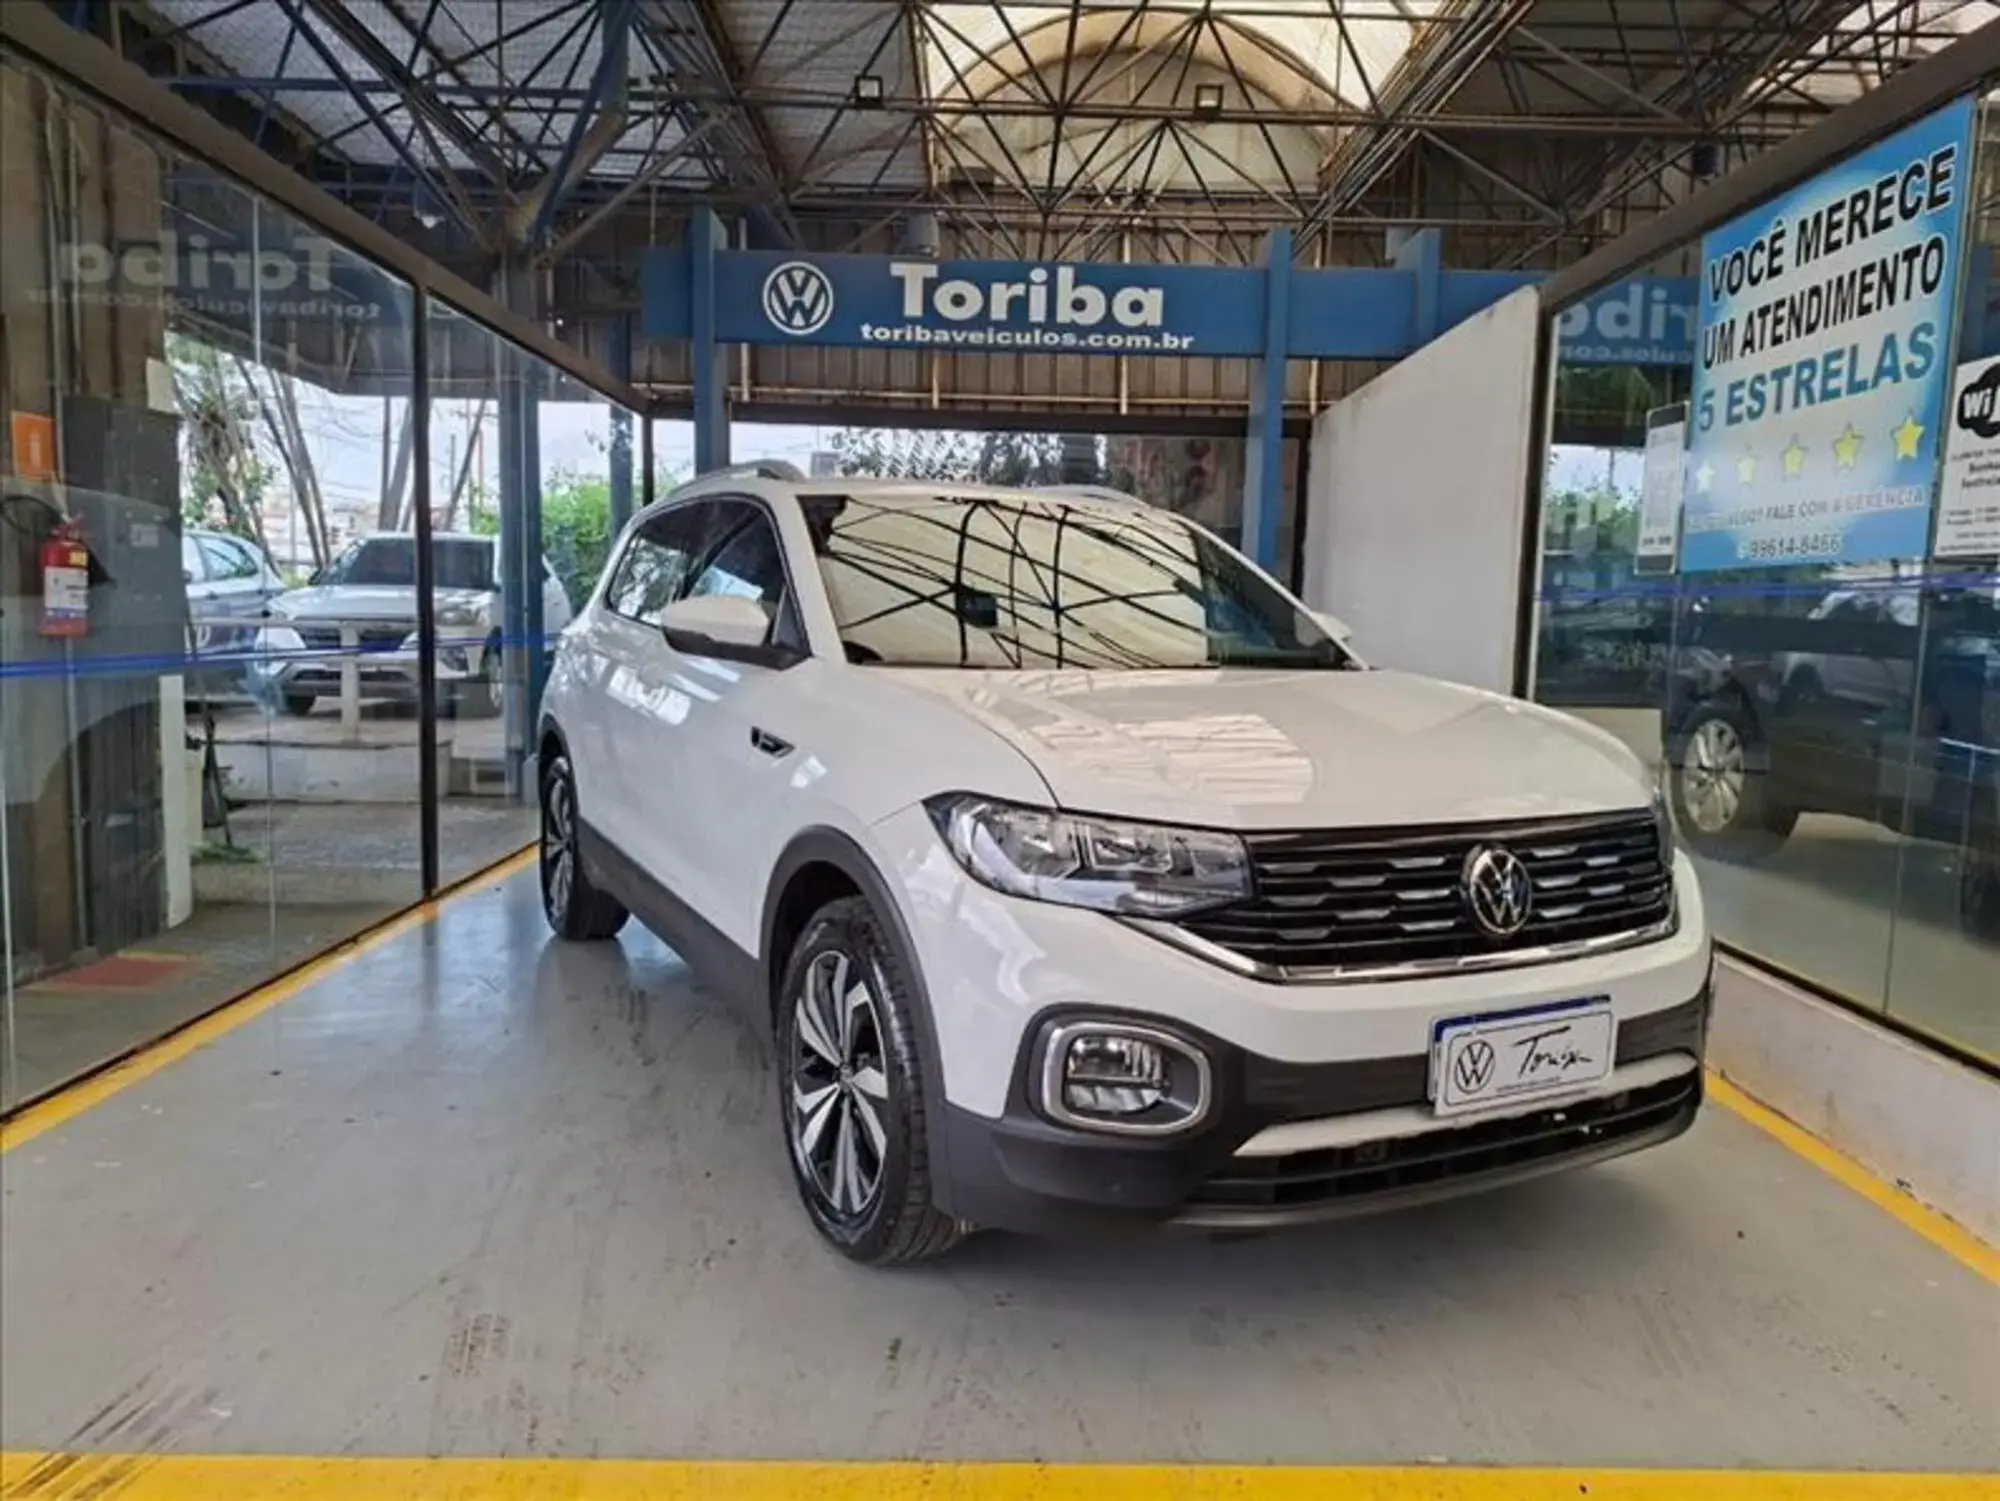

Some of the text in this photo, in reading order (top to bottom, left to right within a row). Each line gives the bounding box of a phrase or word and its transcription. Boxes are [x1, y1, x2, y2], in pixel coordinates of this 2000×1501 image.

[1711, 147, 1955, 302] VOCÊ MERECE
[860, 322, 1196, 350] toribaveiculos.com.br
[889, 262, 1164, 327] Toriba
[1704, 237, 1944, 370] UM ATENDIMENTO
[1700, 322, 1936, 432] 5 ESTRELAS
